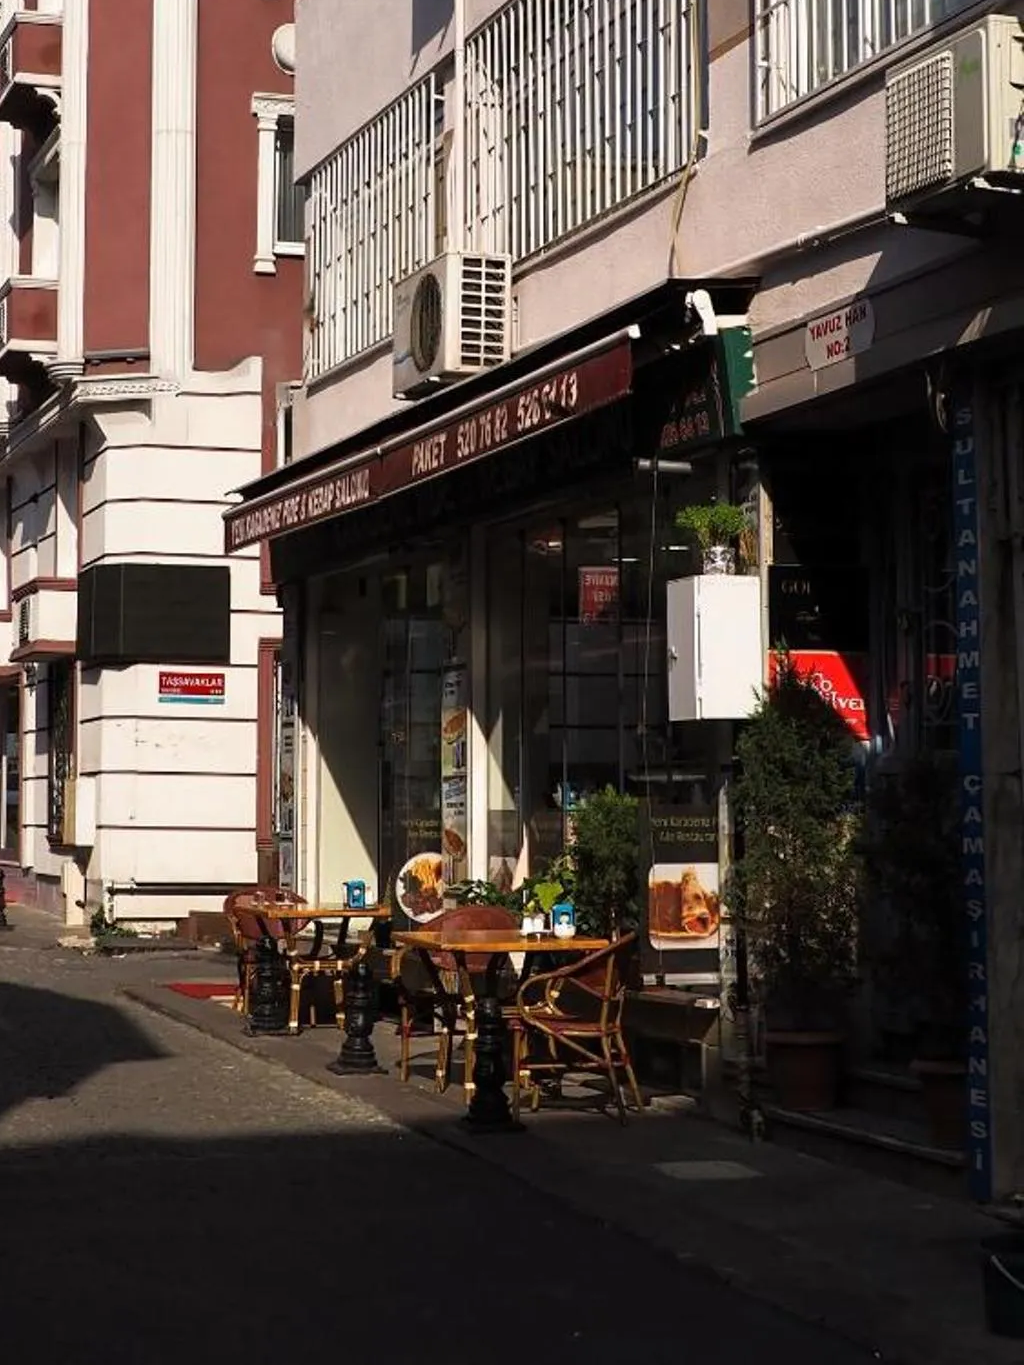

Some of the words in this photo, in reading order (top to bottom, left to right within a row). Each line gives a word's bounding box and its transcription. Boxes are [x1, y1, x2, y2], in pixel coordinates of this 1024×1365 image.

[809, 315, 842, 341] YAVUZ
[845, 305, 867, 327] HAN
[411, 431, 448, 477] PAKET
[955, 407, 981, 732] SULTANAHMET
